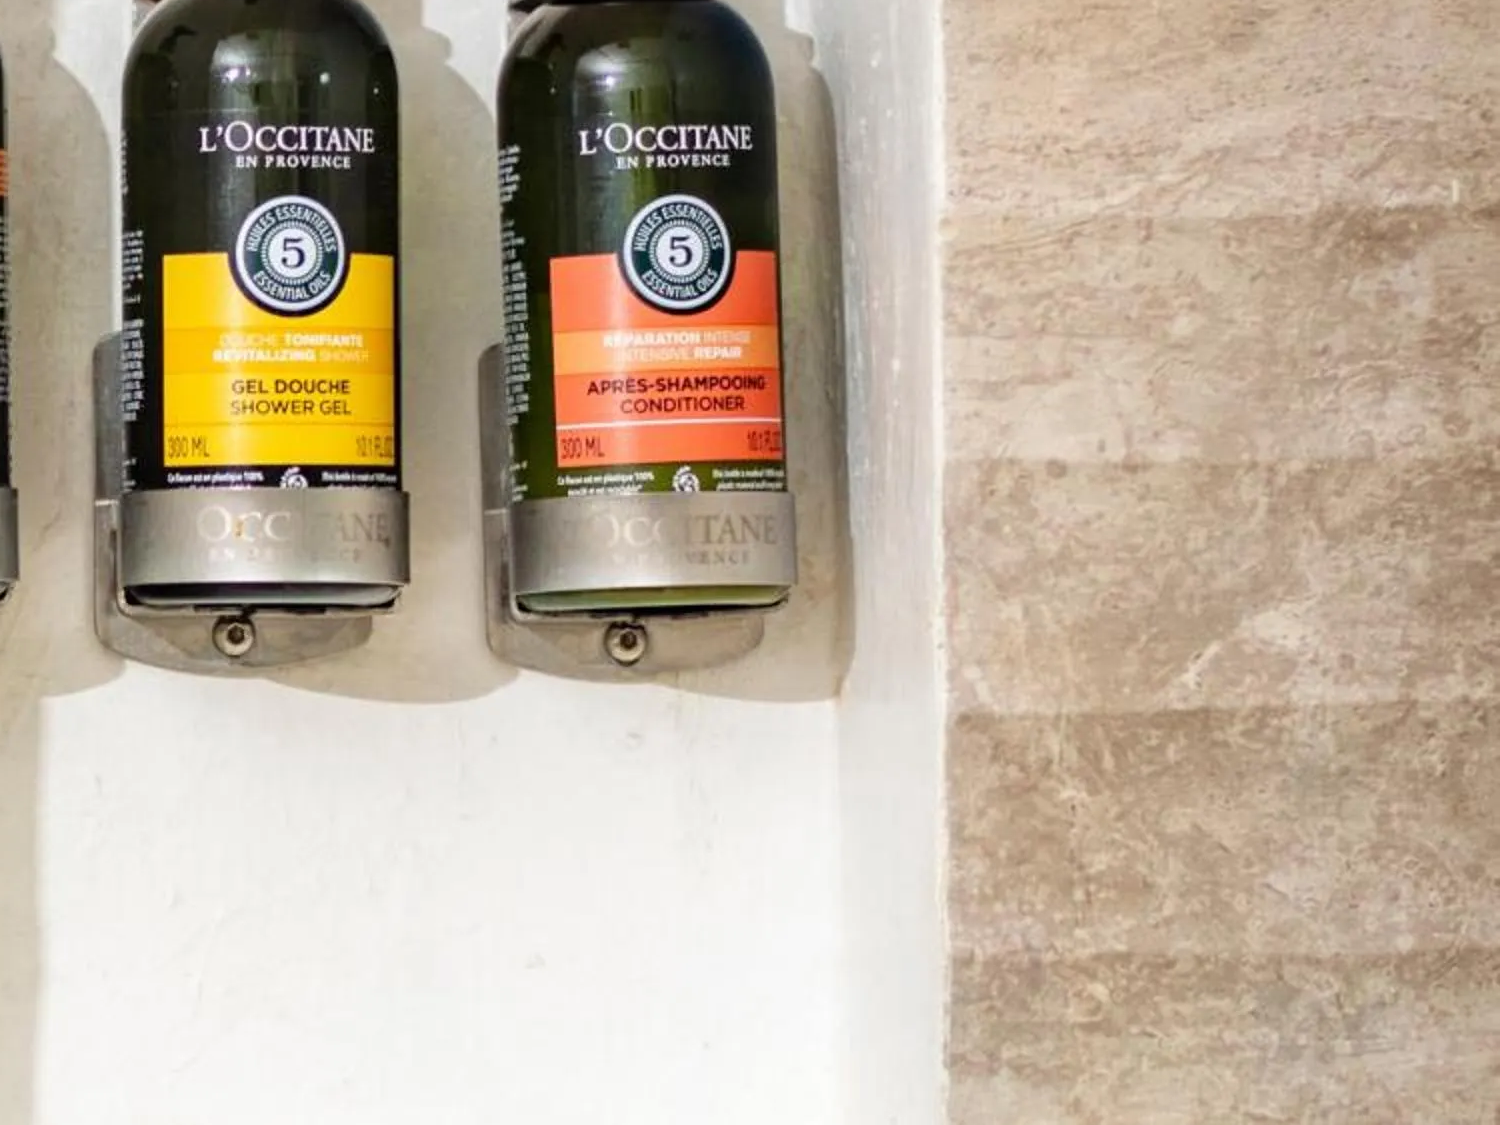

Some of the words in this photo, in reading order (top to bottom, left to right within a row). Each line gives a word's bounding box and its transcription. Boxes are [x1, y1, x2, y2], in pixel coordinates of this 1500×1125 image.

[199, 120, 375, 153] L'OCCITANE
[579, 122, 753, 156] L'OCCITANE
[235, 155, 258, 168] EN
[265, 155, 351, 168] PROVENCE
[616, 155, 639, 170] EN
[645, 154, 731, 168] PROVENCE
[275, 205, 337, 252] ESSENTIELLES
[661, 205, 722, 250] ESSENTIELLES
[281, 237, 306, 269] 5
[669, 236, 693, 268] 5
[253, 270, 311, 300] ESSENTIAL
[308, 270, 331, 294] OILS
[642, 270, 699, 298] ESSENTIAL
[695, 346, 742, 360] REPAIR
[231, 379, 269, 394] GEL
[274, 379, 351, 395] DOUCHE
[587, 374, 766, 396] APRÈS-SHAMPOOING
[231, 400, 315, 416] SHOWER
[319, 400, 352, 416] GEL
[620, 395, 746, 414] CONDITIONER
[191, 436, 210, 458] ML
[561, 437, 582, 460] 300
[585, 435, 606, 458] ML
